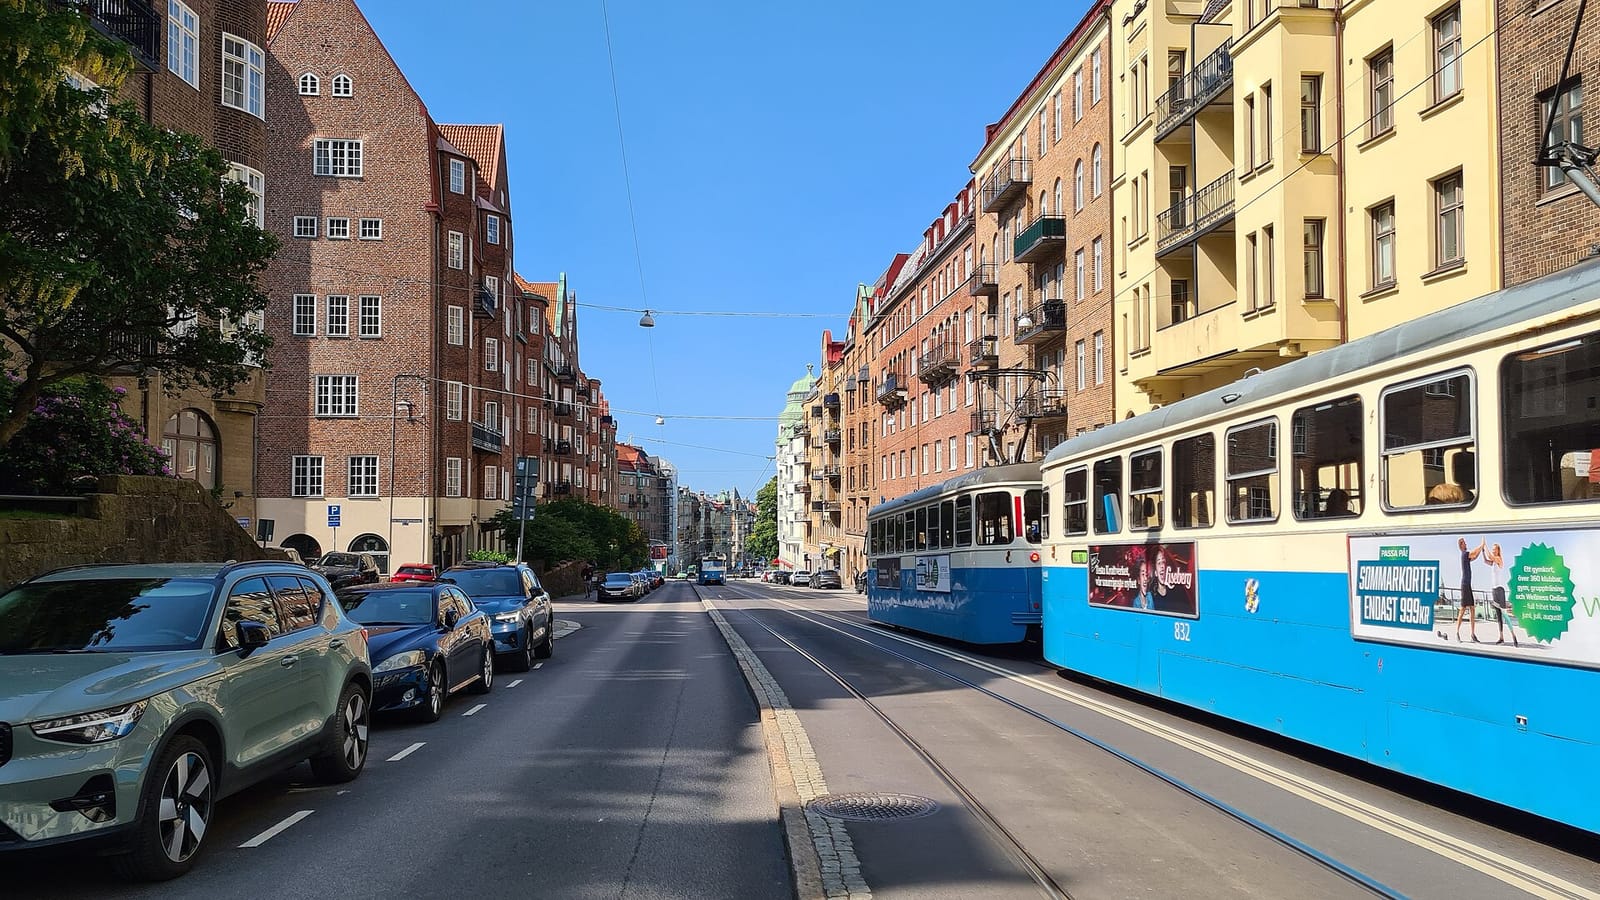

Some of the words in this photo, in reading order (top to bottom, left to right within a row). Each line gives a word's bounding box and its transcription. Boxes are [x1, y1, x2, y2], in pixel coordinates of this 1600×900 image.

[1164, 565, 1192, 589] Liseberg
[1359, 566, 1437, 593] SOMMARKORTET
[1364, 595, 1398, 622] ENDAST
[1174, 621, 1191, 641] 832
